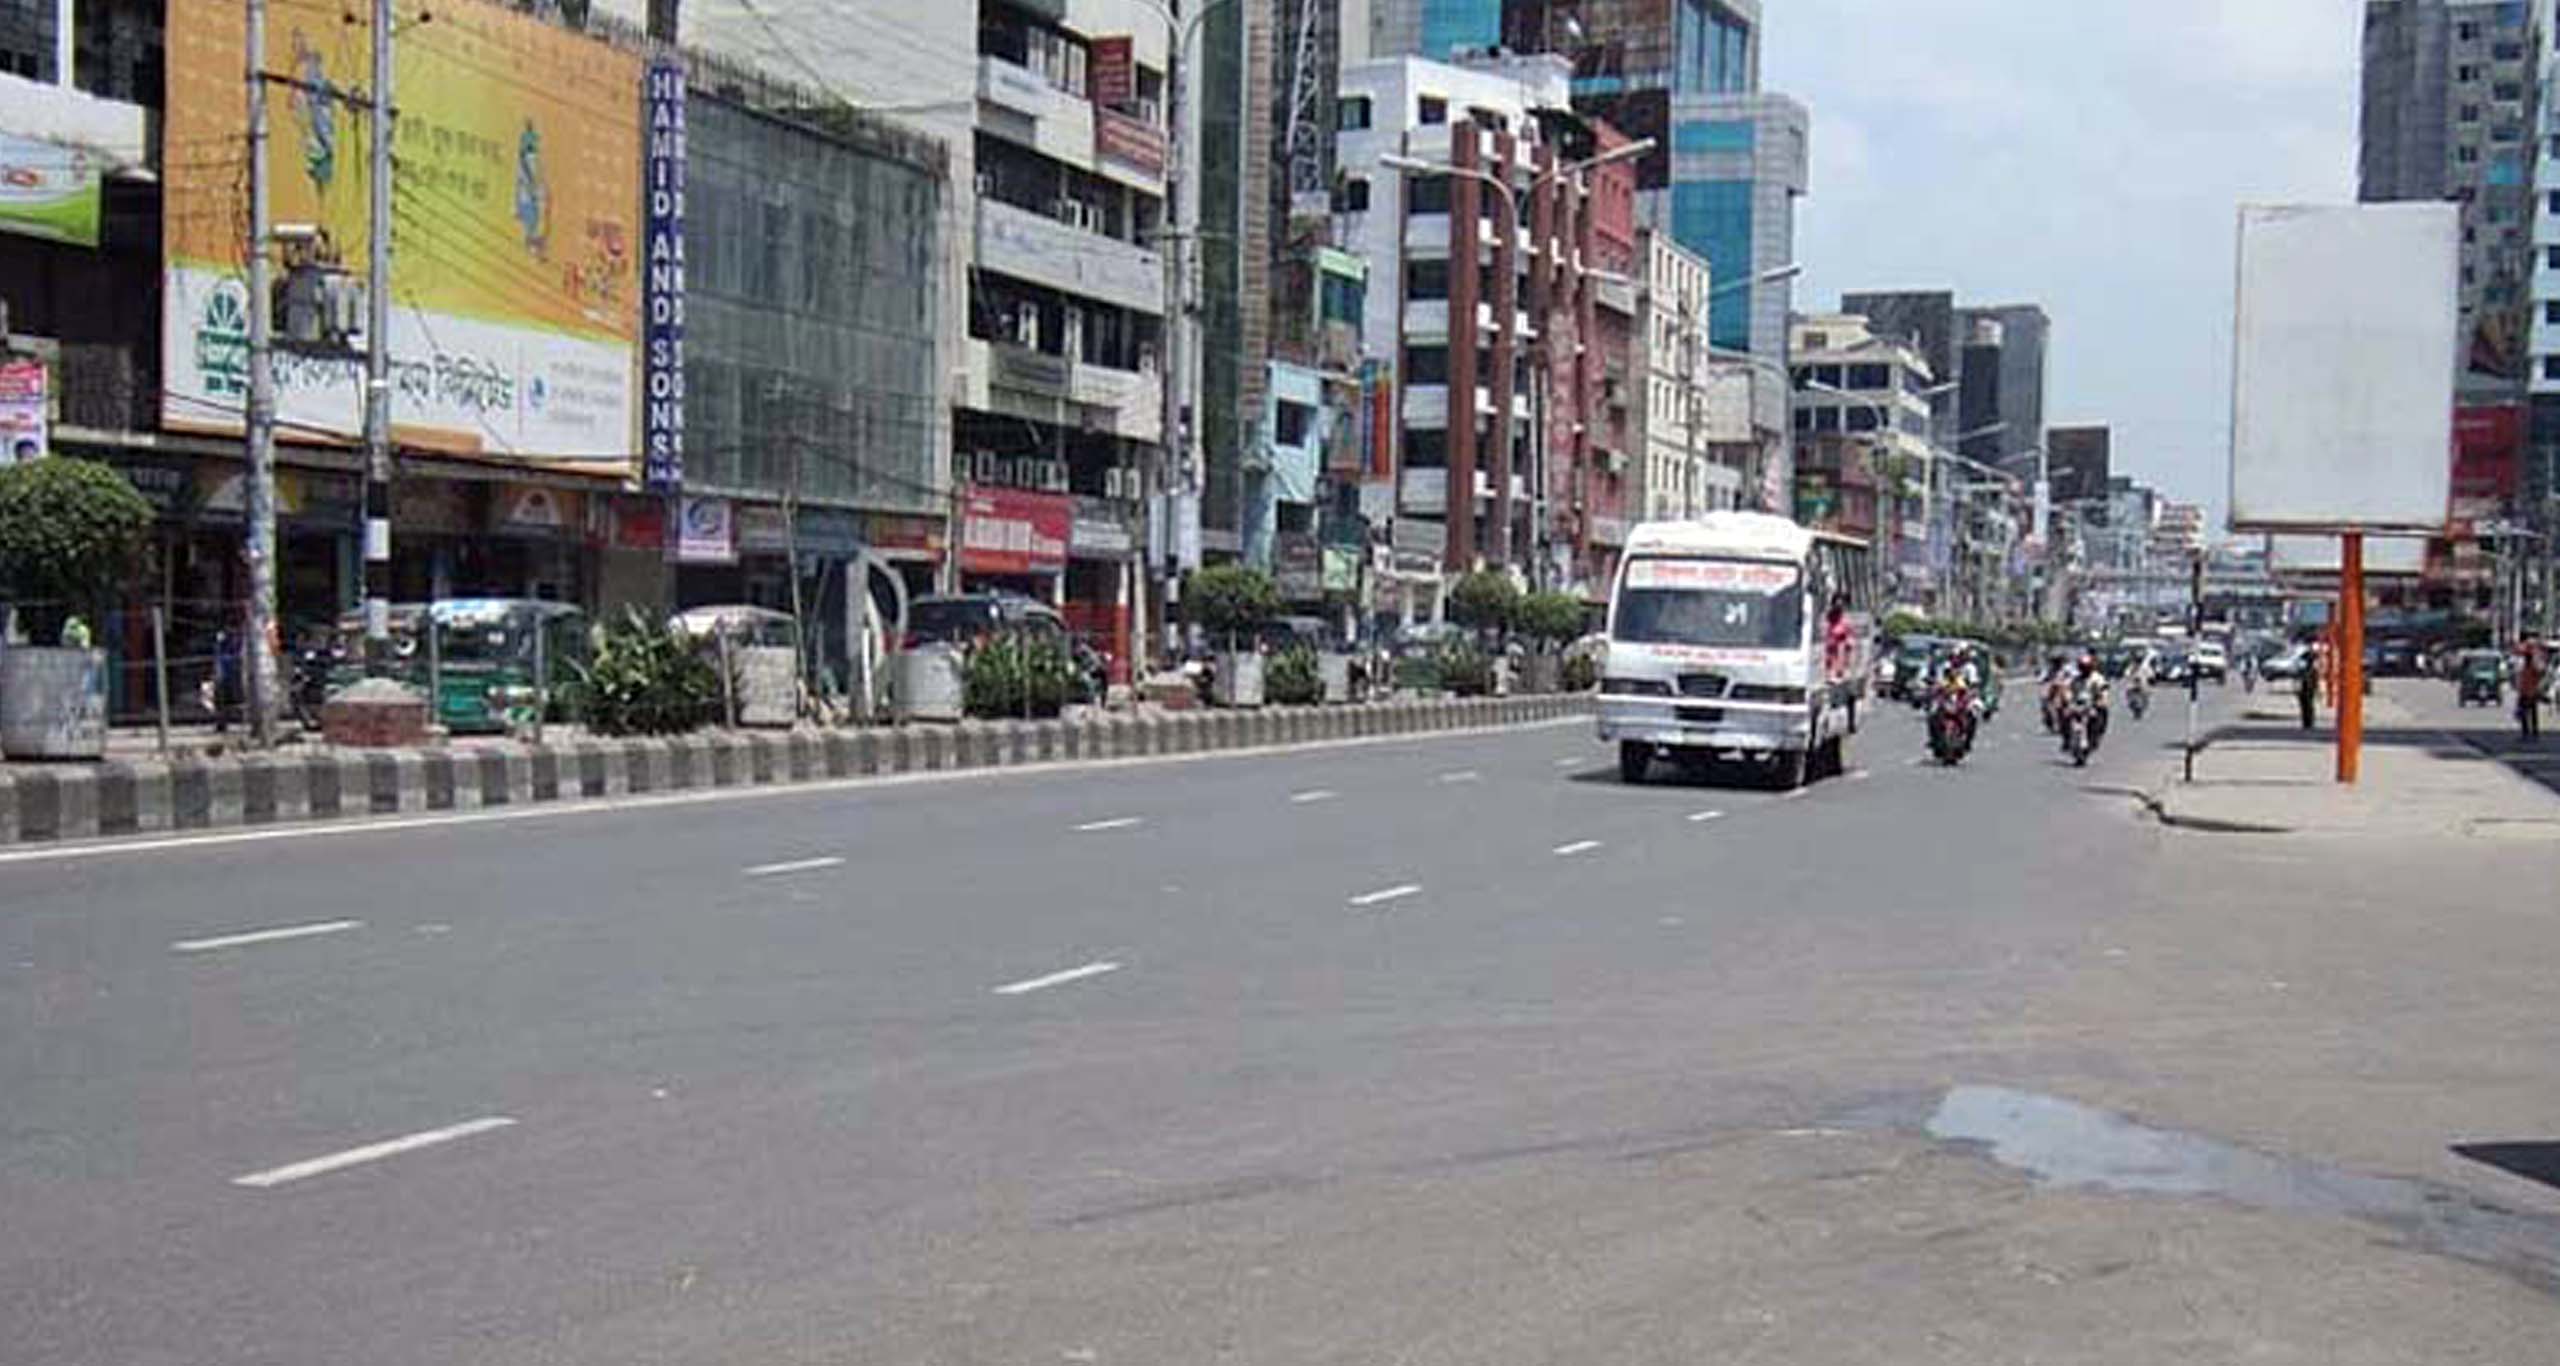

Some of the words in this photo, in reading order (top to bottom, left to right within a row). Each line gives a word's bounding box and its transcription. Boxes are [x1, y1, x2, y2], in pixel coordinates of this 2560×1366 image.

[652, 72, 671, 217] HAMID
[652, 233, 671, 325] AND
[651, 338, 671, 461] SONS
